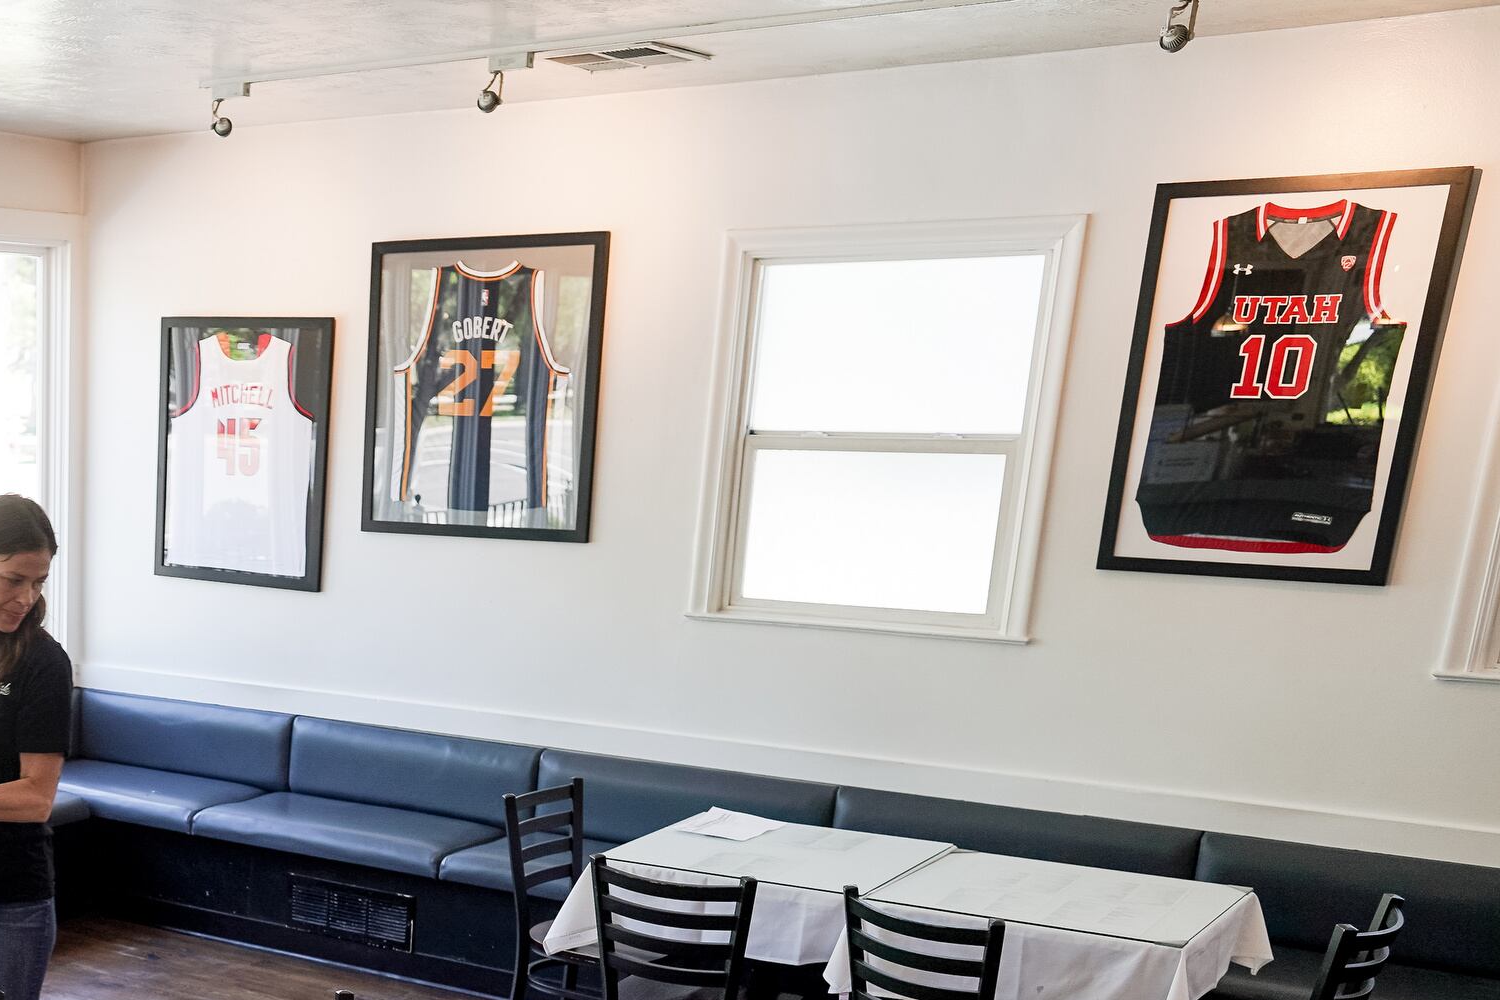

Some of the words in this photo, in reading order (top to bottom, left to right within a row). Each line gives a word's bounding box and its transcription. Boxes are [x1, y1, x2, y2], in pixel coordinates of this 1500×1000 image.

[452, 316, 514, 344] GOBERT
[1233, 294, 1343, 325] UTAH
[437, 349, 520, 417] 27
[1230, 334, 1318, 399] 10
[211, 383, 274, 410] MITCHELL
[216, 417, 262, 477] 45
